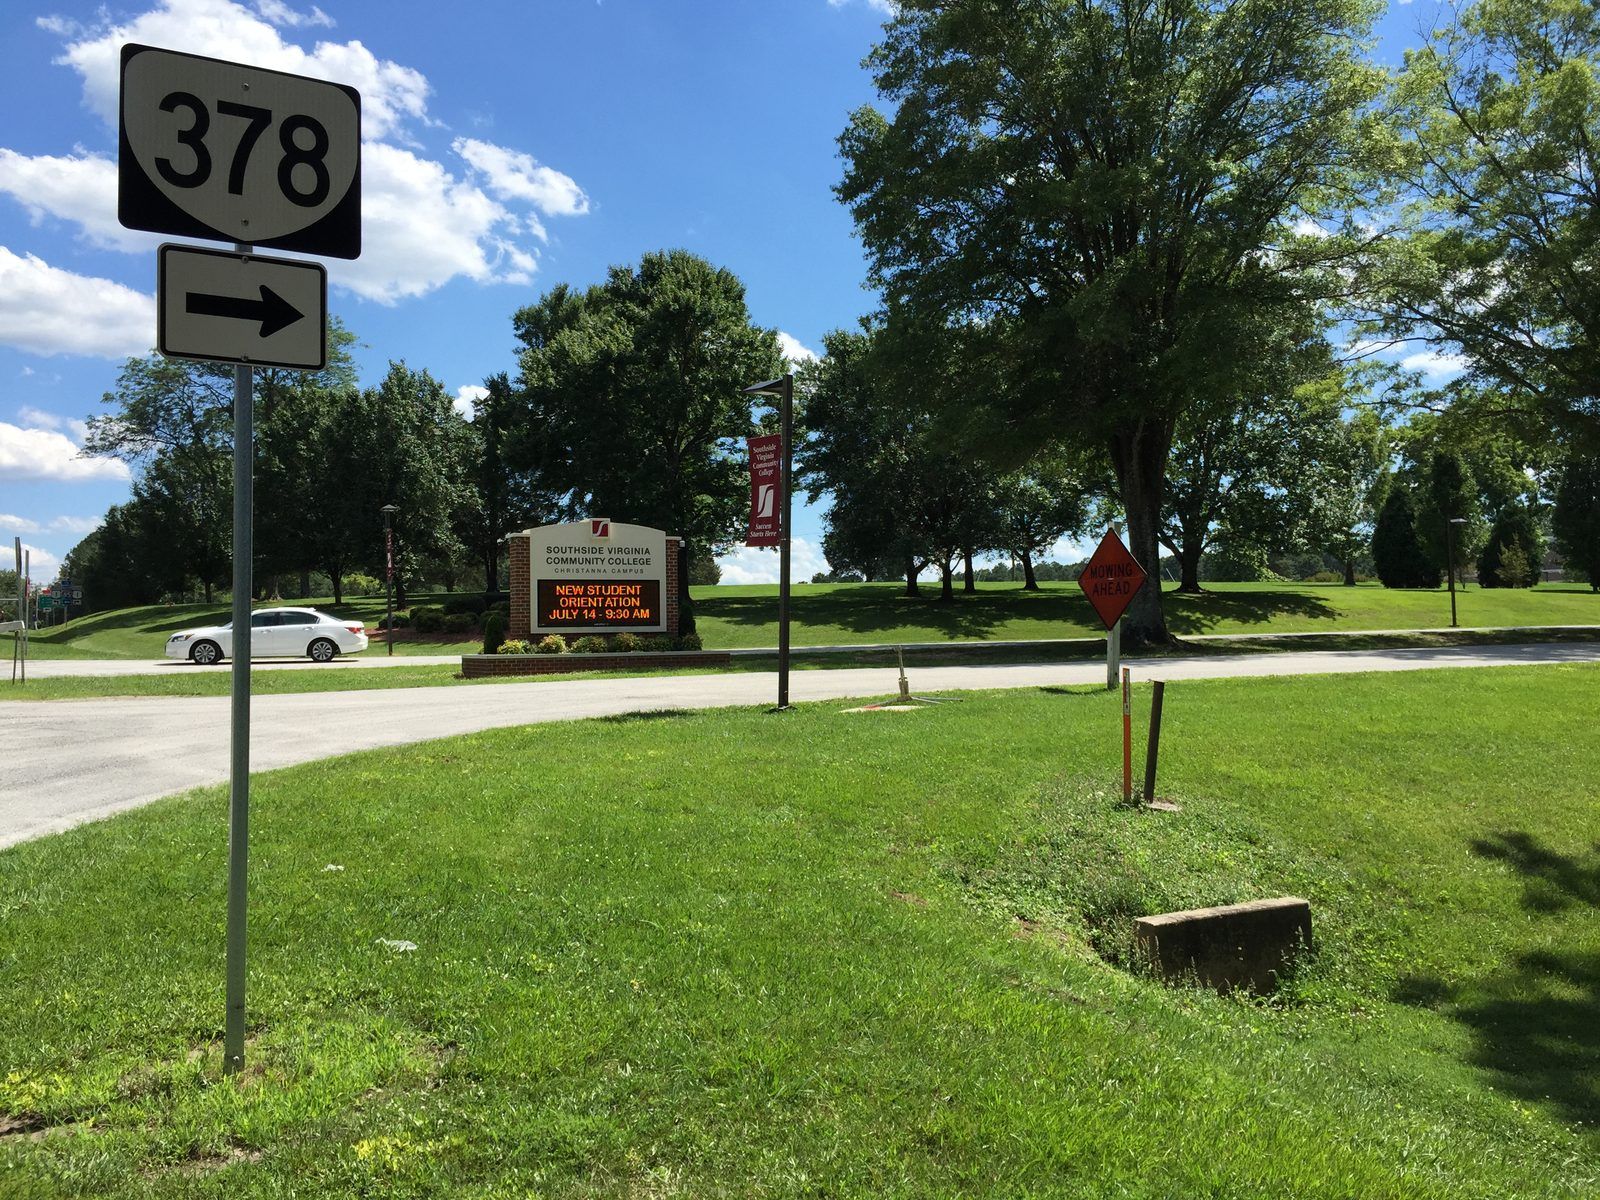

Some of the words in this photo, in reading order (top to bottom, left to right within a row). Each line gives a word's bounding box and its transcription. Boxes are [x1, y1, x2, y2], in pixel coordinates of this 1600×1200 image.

[154, 91, 330, 207] 378
[546, 546, 604, 555] SOUTHSIDE
[607, 547, 651, 555] VIRGINIA
[546, 557, 605, 566] COMMUNITY
[607, 557, 652, 566] COLLEGE
[1091, 563, 1132, 579] MOWING
[556, 586, 584, 595] NEW
[587, 586, 642, 595] STUDENT
[1093, 582, 1130, 596] AHEAD
[560, 598, 640, 607] ORIENTATION
[549, 610, 579, 619] JULY
[582, 610, 596, 619] 14
[605, 609, 630, 619] 9:30
[632, 609, 650, 619] AM
